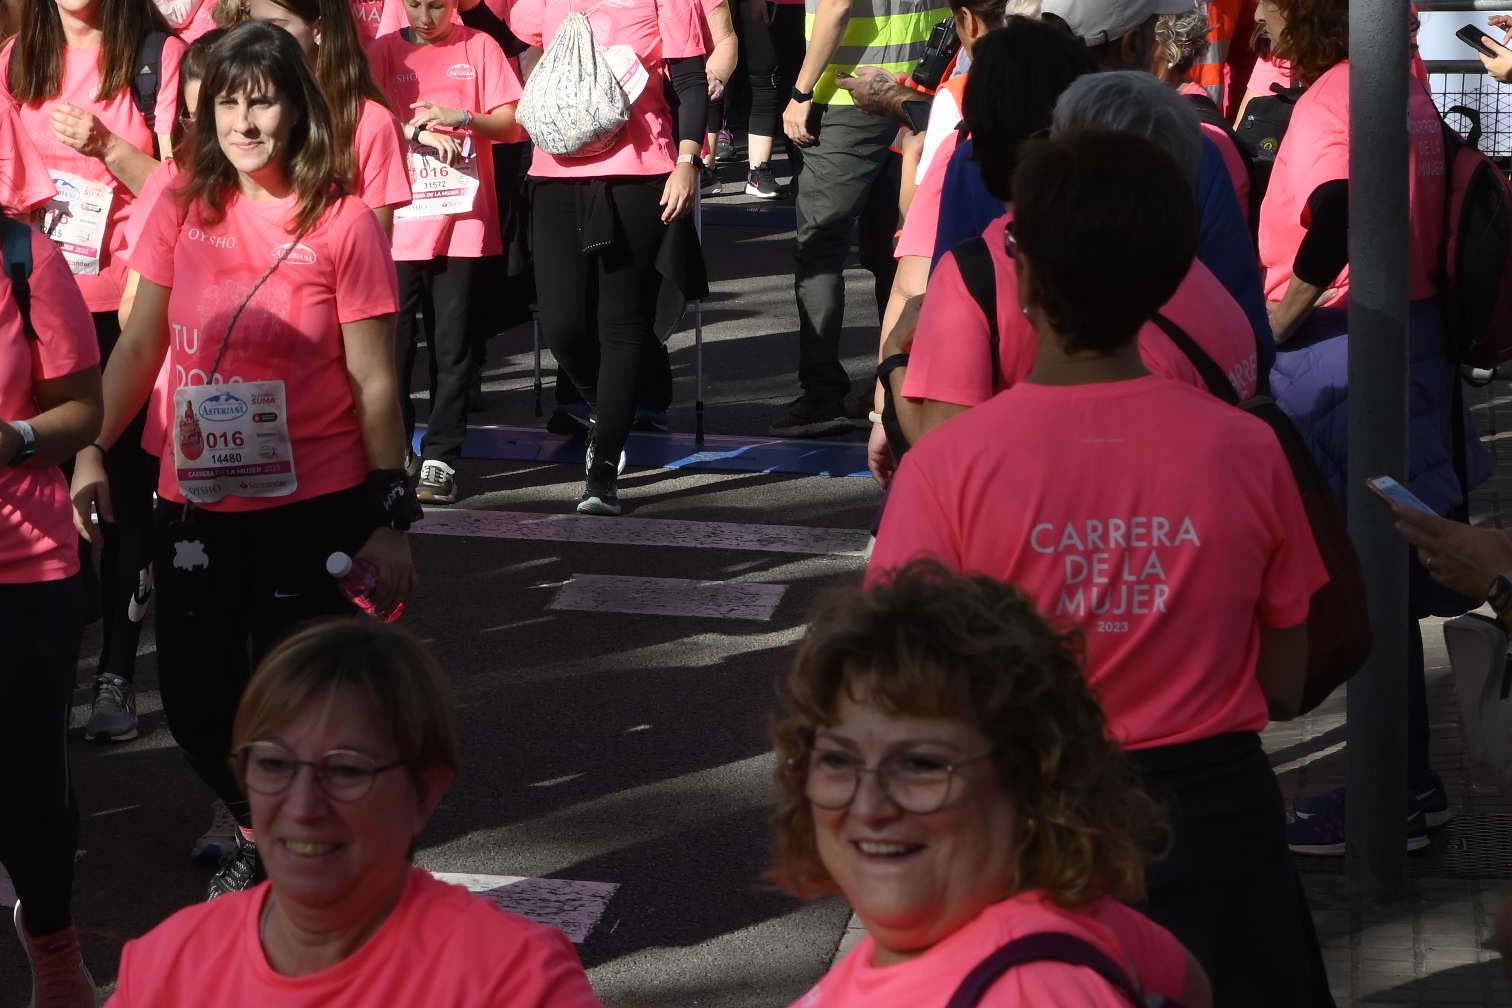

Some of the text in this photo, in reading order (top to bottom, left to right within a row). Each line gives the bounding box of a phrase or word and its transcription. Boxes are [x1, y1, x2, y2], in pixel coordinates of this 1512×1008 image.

[420, 166, 448, 179] 016
[188, 227, 236, 249] OYSHO
[172, 323, 200, 354] TU
[206, 431, 245, 448] 016
[211, 453, 242, 464] 14480
[1030, 516, 1201, 553] CARRERA
[1065, 550, 1166, 584] DE LA
[1056, 584, 1170, 617] MUJER
[1097, 621, 1129, 632] 2023
